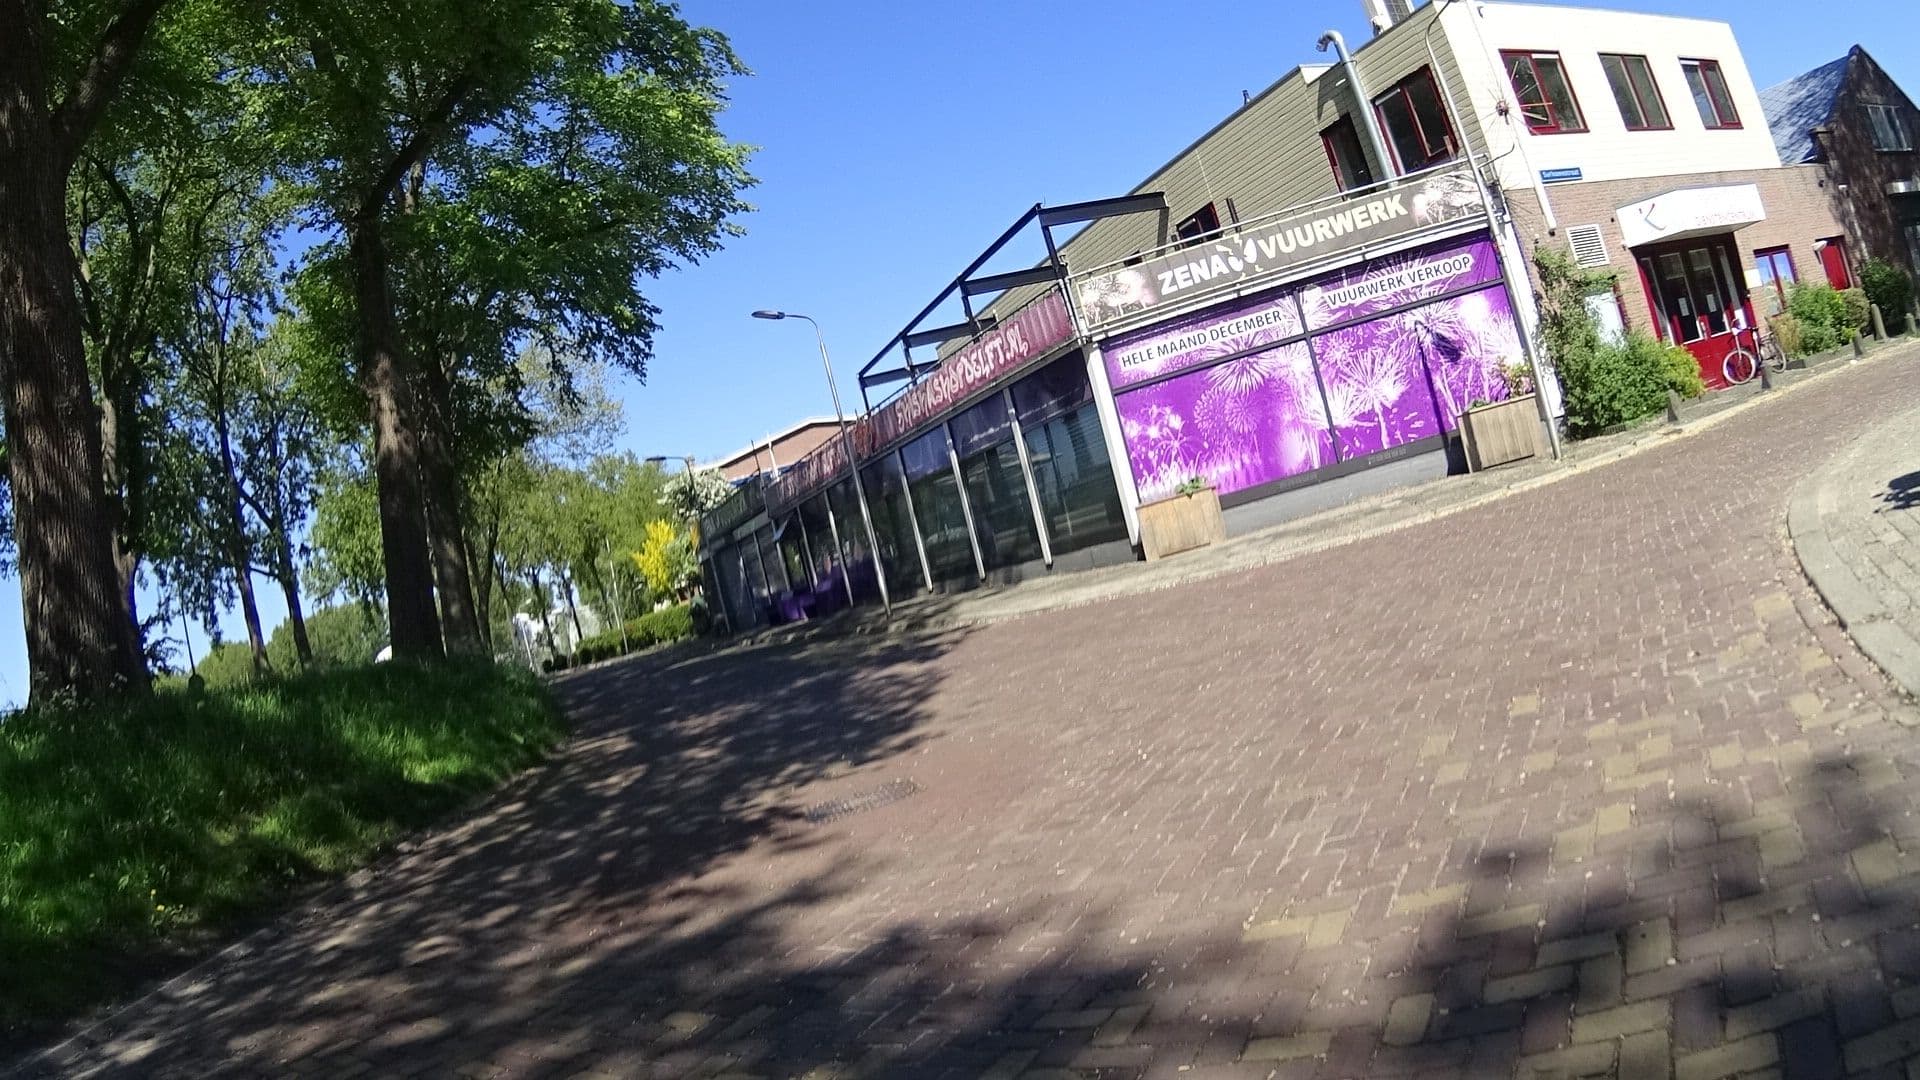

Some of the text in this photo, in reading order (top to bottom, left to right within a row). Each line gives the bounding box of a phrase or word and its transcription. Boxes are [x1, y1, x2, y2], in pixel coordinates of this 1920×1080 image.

[1158, 193, 1409, 296] ZENA VUURWERK
[1328, 256, 1471, 306] VUURWERK VERKOOP
[1121, 310, 1283, 368] HELE MAAND DECEMBER
